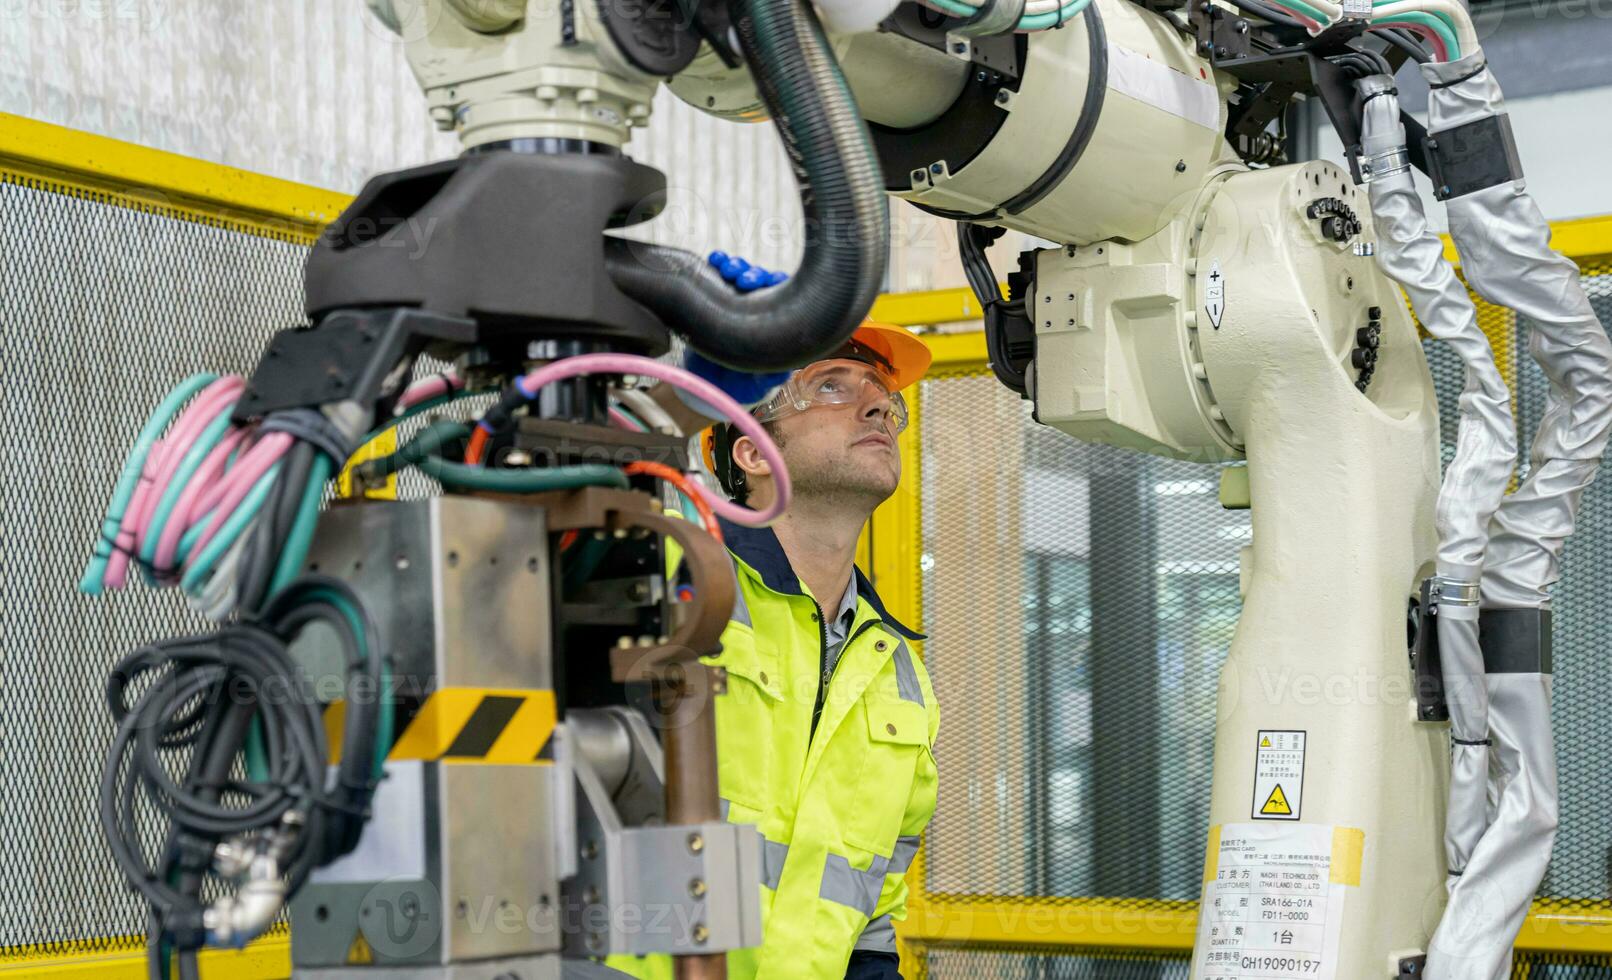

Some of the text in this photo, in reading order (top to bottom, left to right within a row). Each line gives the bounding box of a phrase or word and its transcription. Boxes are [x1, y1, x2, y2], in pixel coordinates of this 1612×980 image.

[1282, 872, 1320, 881] TECHNOLOGY
[1216, 881, 1250, 890] CUSTOMER
[1261, 897, 1313, 908] SRA166-01A
[1261, 910, 1310, 921] FD11-0000
[1211, 938, 1240, 946] QUANTITY
[1241, 956, 1321, 974] CH19090197
